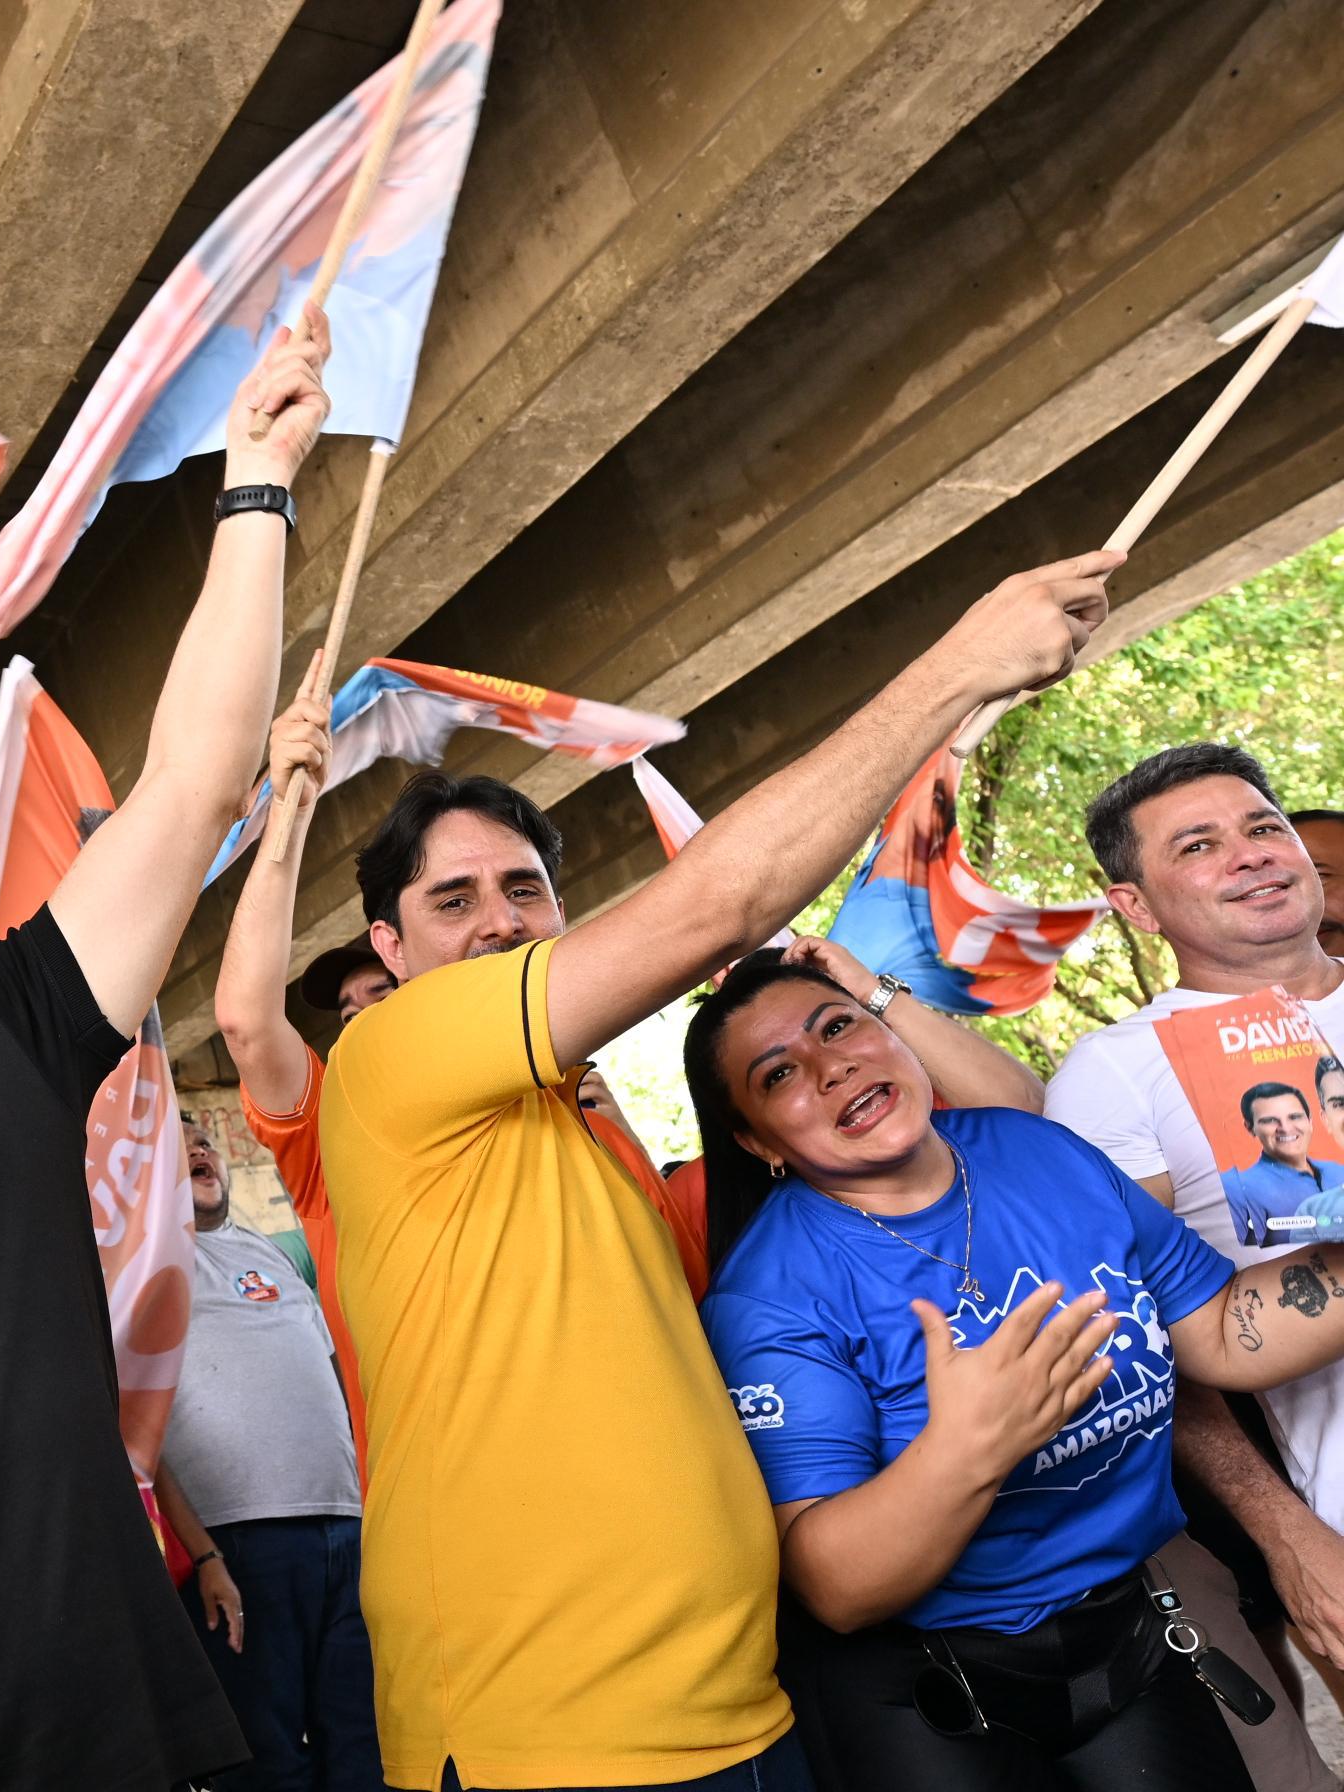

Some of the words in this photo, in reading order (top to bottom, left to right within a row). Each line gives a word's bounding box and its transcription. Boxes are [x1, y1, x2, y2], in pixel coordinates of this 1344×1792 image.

[1219, 1014, 1313, 1055] DAVID
[1250, 1042, 1314, 1065] RENATO
[1033, 1377, 1174, 1475] AMAZONAS
